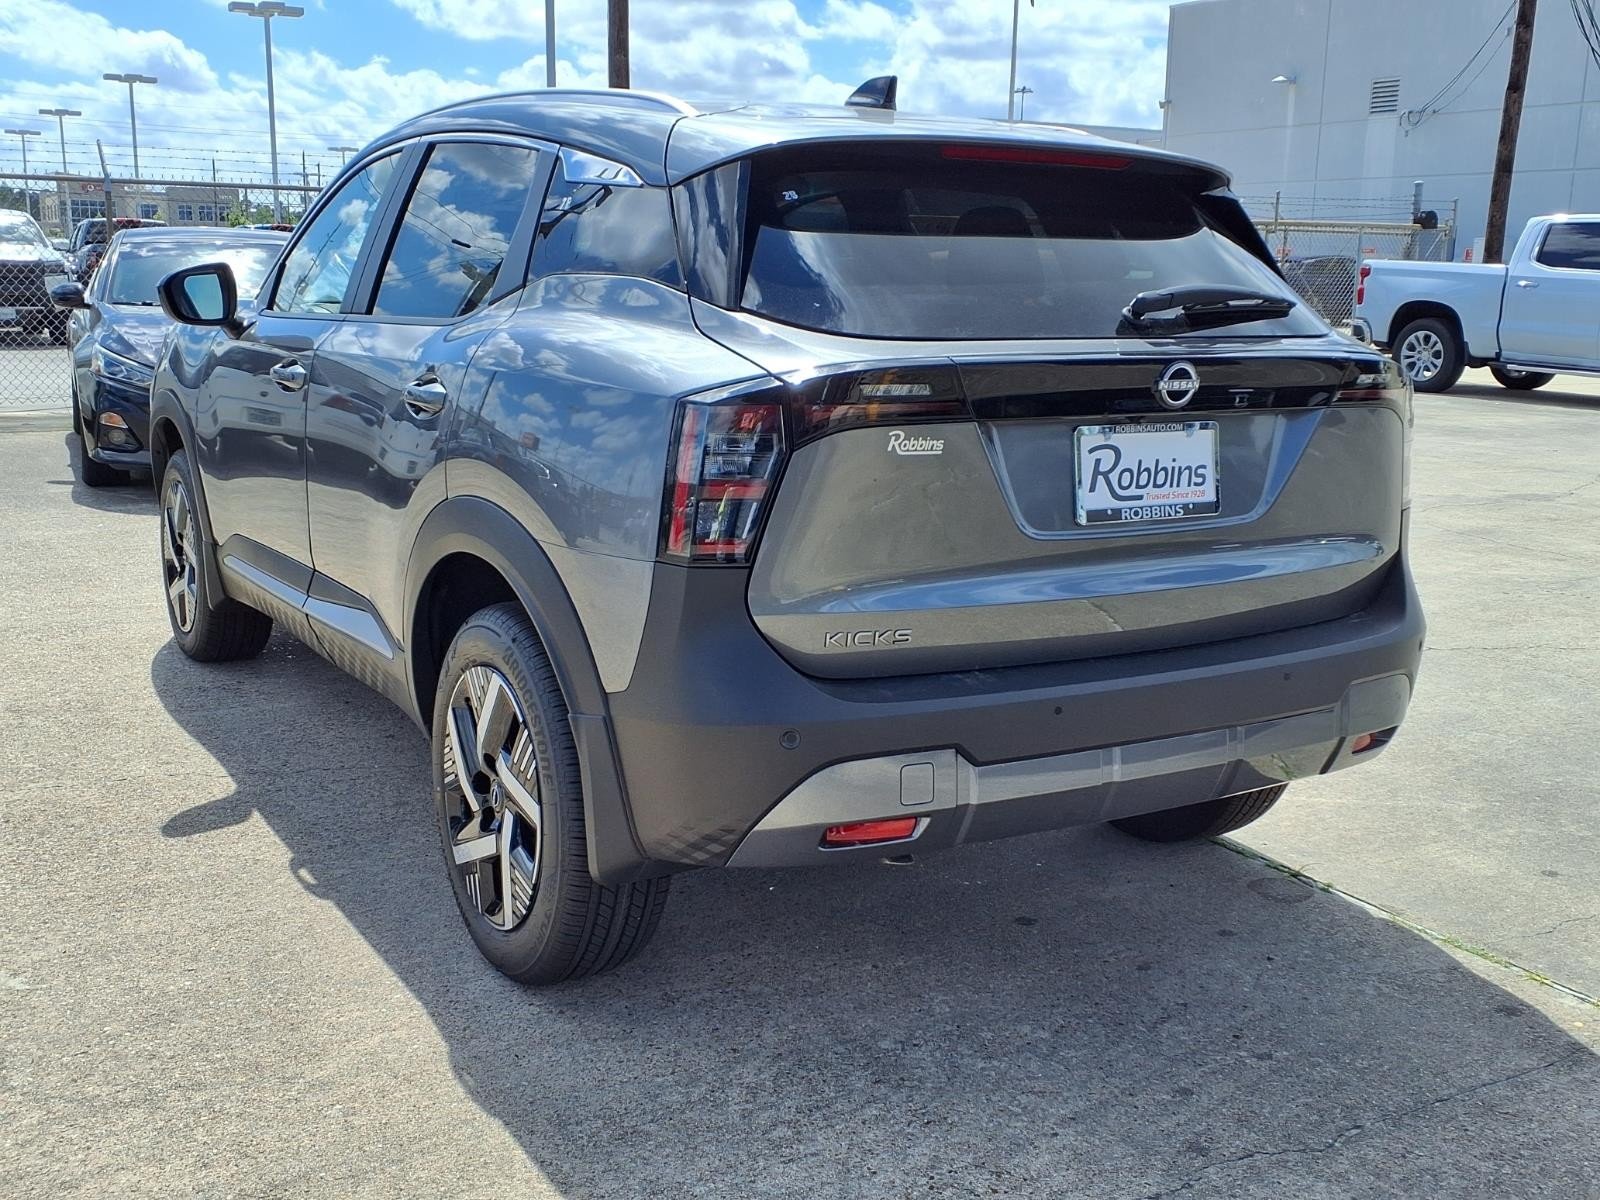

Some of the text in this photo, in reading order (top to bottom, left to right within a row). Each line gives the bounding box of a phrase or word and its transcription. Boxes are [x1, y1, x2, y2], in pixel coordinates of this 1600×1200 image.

[1158, 380, 1199, 391] NISSAN
[1115, 423, 1183, 433] ROBBINSAUTO.COM
[887, 430, 945, 455] Robbins
[1087, 443, 1207, 502] Robbins
[1146, 489, 1206, 501] Trusted Since 1928
[1121, 504, 1185, 520] ROBBINS
[823, 628, 913, 648] KICKS
[502, 645, 553, 786] BRIDGESTONE
